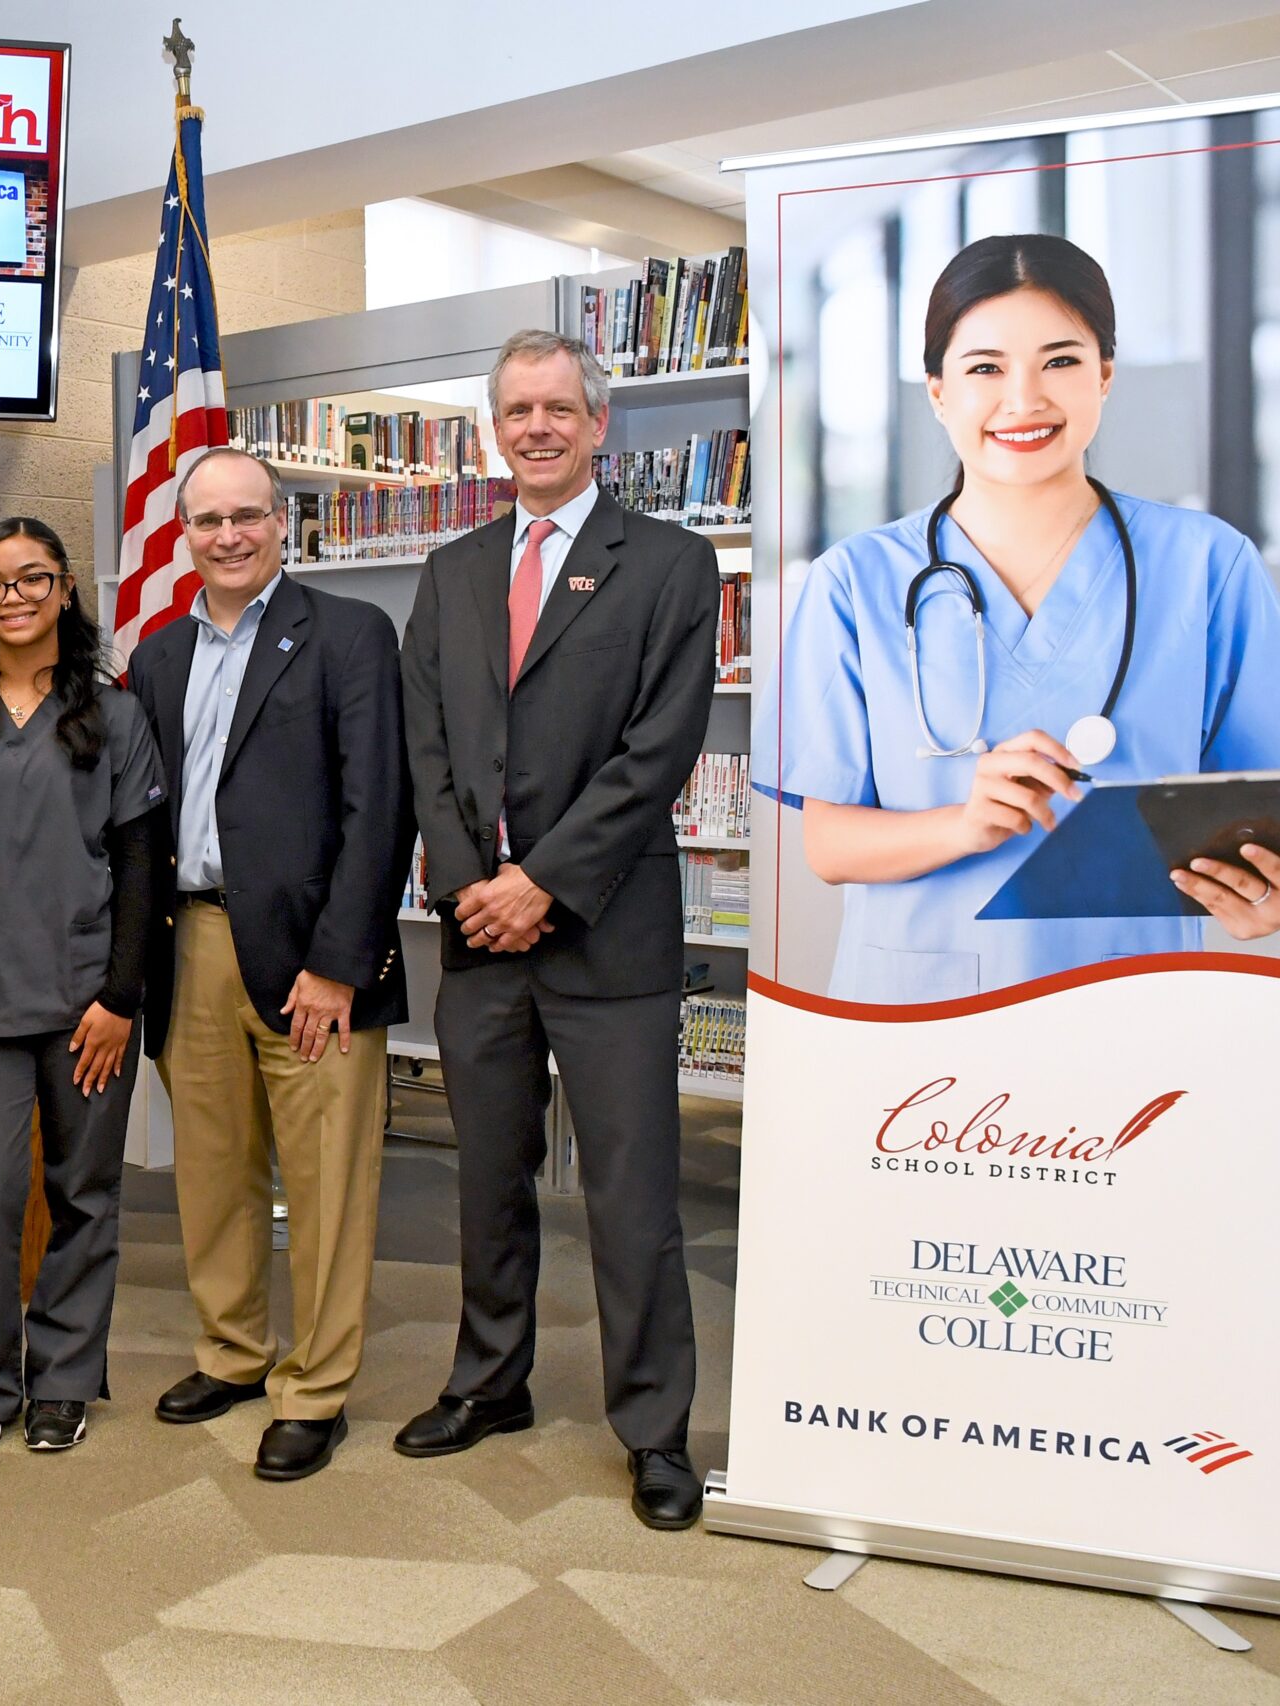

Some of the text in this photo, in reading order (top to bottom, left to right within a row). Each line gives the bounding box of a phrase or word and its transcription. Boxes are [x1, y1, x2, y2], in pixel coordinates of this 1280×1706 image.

[568, 576, 595, 592] WE
[875, 1077, 1189, 1163] Colonial
[871, 1157, 1118, 1186] SCHOOL DISTRICT
[911, 1240, 1127, 1288] DELAWARE
[870, 1279, 1168, 1322] TECHNICAL COMMUNITY
[919, 1315, 1113, 1363] COLLEGE
[784, 1400, 1151, 1465] BANK OF AMERICA
